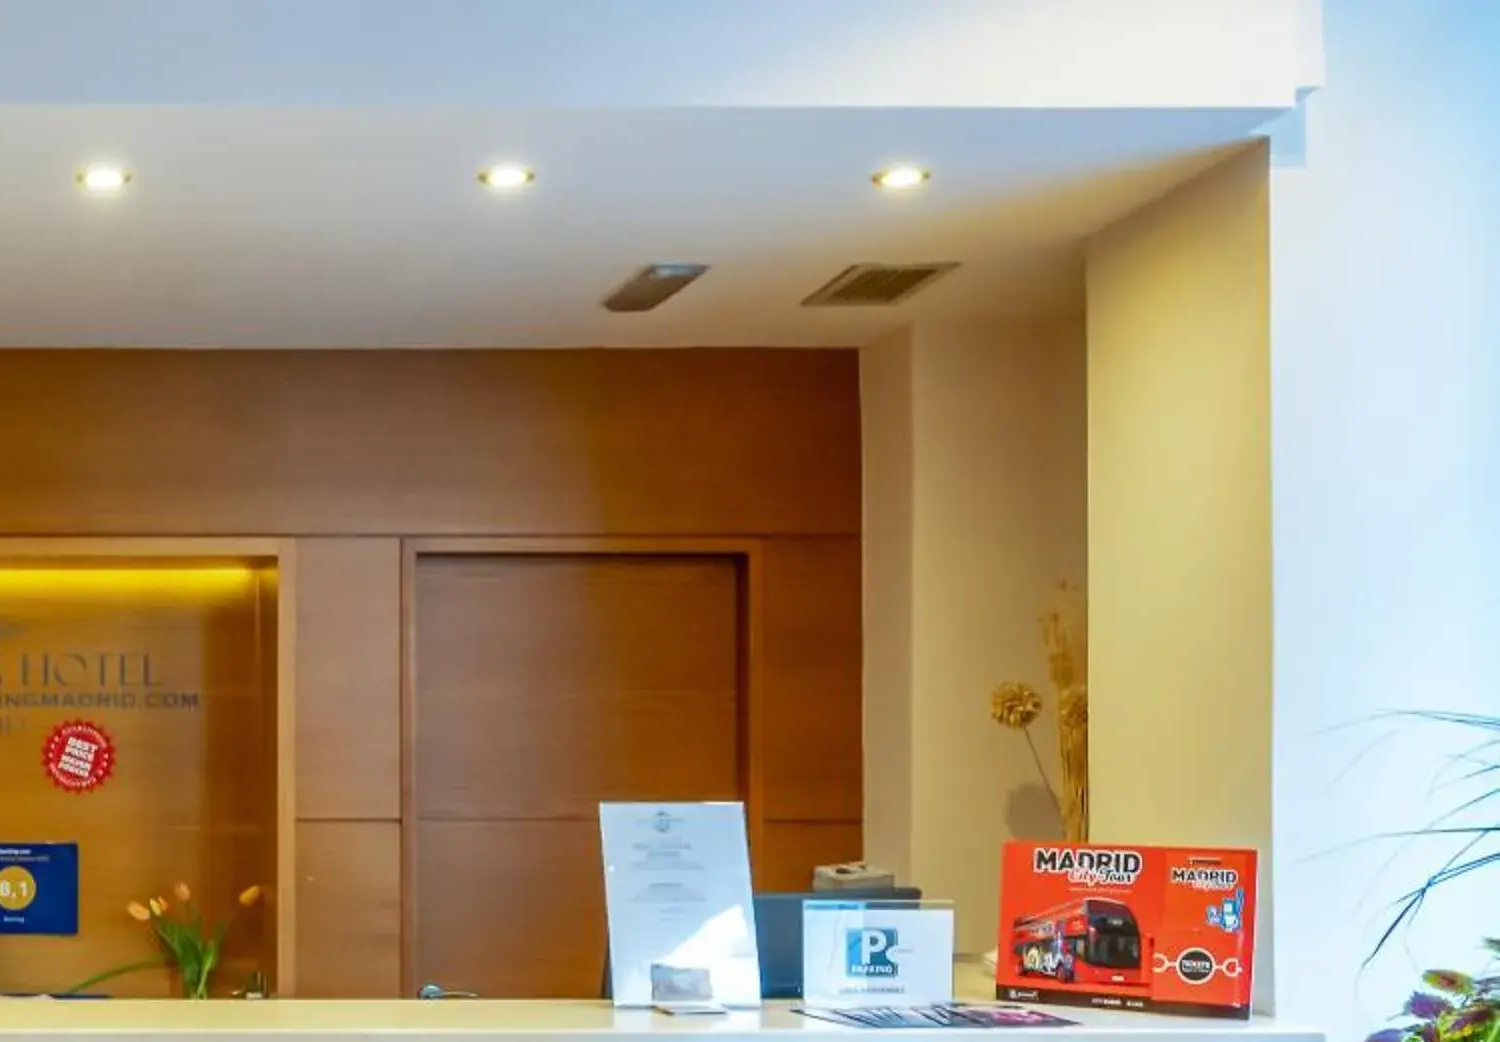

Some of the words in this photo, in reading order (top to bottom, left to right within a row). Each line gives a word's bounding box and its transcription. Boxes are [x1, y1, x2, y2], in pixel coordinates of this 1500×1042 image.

[19, 652, 164, 686] HOTEL
[1035, 848, 1142, 874] MADRID
[1171, 868, 1238, 884] MADRID
[861, 929, 887, 964] P
